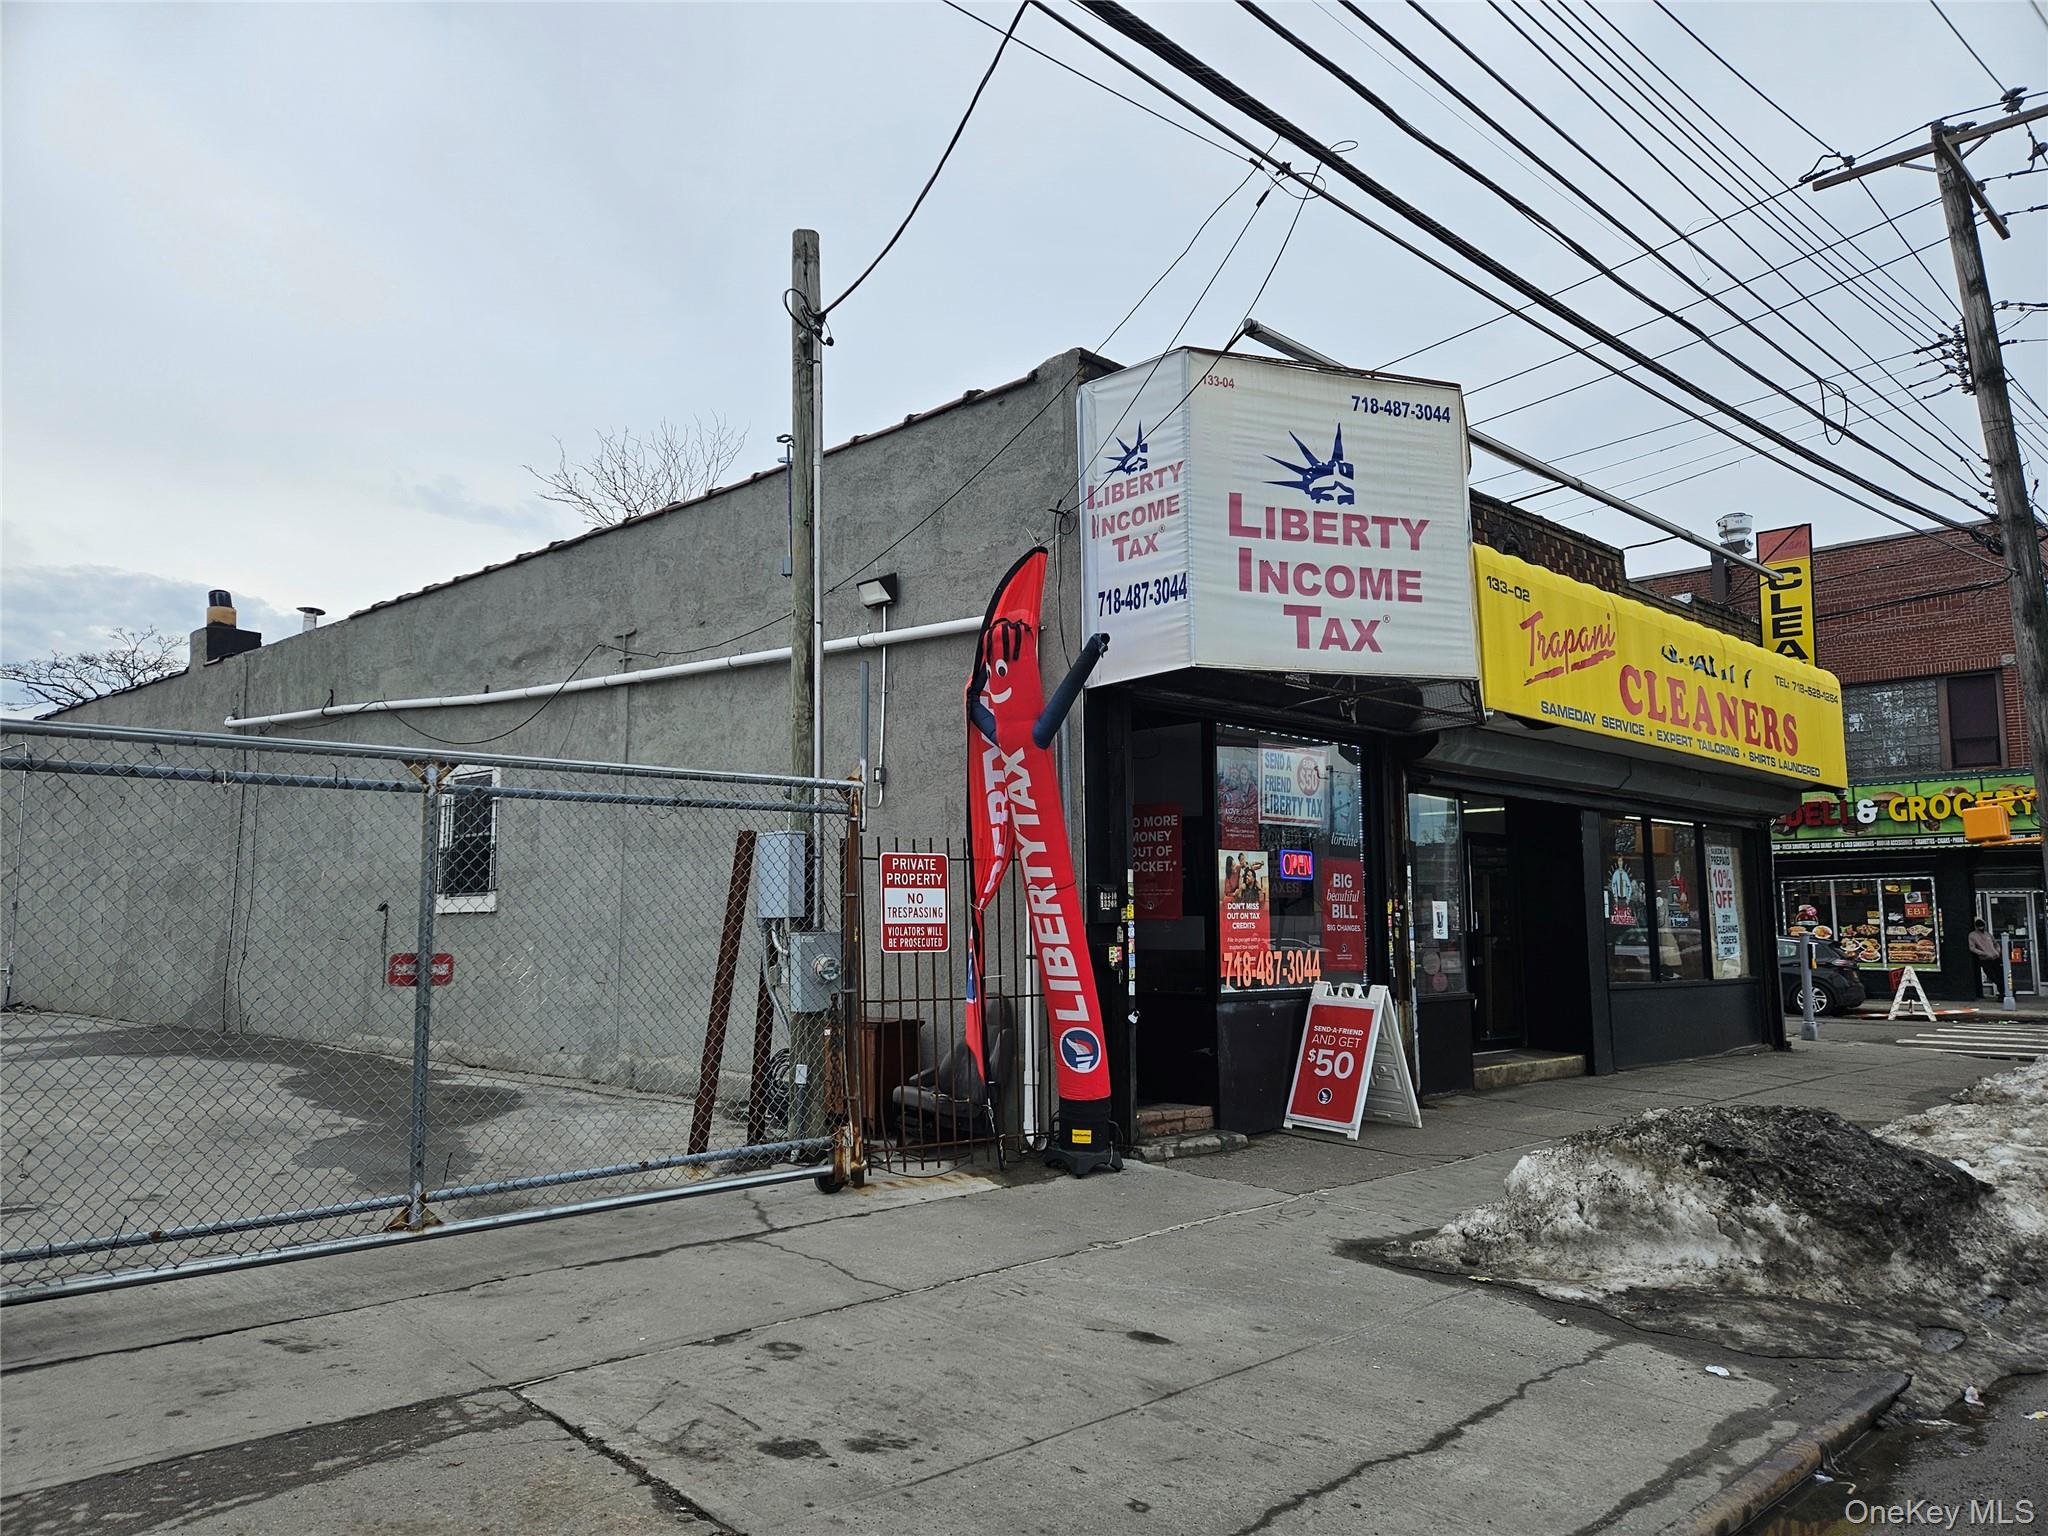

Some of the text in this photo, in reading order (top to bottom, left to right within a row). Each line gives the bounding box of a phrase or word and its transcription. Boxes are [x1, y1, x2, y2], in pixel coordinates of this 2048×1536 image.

[1203, 375, 1234, 388] 133-04
[1351, 395, 1451, 424] 718-487-3044
[1087, 460, 1185, 510] LIBERTY
[1091, 493, 1180, 540] INCOME
[1228, 492, 1430, 551] LIBERTY
[1238, 547, 1423, 603] INCOME
[1098, 572, 1187, 617] 718-487-3044
[1486, 575, 1530, 603] 133-02
[1768, 566, 1809, 662] CLEA
[1519, 610, 1616, 674] Trapani
[1774, 675, 1790, 688] TEL:
[1619, 665, 1799, 757] CLEANERS
[1541, 700, 1821, 778] SAMEDAY SERVICE EXPERT TAILORING SHIRTS LAUNDERED
[1265, 751, 1292, 771] SEND A
[1265, 775, 1292, 793] FRIEND
[1301, 769, 1316, 789] $50
[1264, 794, 1323, 818] LIBERTY TAX
[1857, 798, 1878, 824] &
[1144, 815, 1178, 827] MORE
[1156, 845, 1172, 856] OF
[892, 858, 937, 870] PRIVATE
[1283, 854, 1312, 875] OPEN
[886, 873, 943, 885] PROPERTY
[1000, 747, 1090, 1021] LIBERTY TAX
[1333, 873, 1352, 888] BIG
[1713, 869, 1732, 889] 10%
[907, 893, 924, 904] NO
[1327, 889, 1359, 902] beautiful
[1716, 891, 1732, 908] OFF
[887, 907, 943, 918] TRESPASSING
[1227, 902, 1245, 910] DON'T
[1332, 904, 1358, 919] BILL.
[887, 927, 943, 936] VIOLATORS WILL
[1718, 925, 1738, 934] CLEANING
[888, 938, 943, 948] BE PROSECUTED
[1224, 950, 1321, 990] 718-487-3044
[1313, 1025, 1364, 1036] SEND-A-FRIEND
[1312, 1034, 1362, 1048] AND GET
[1307, 1048, 1354, 1079] $50
